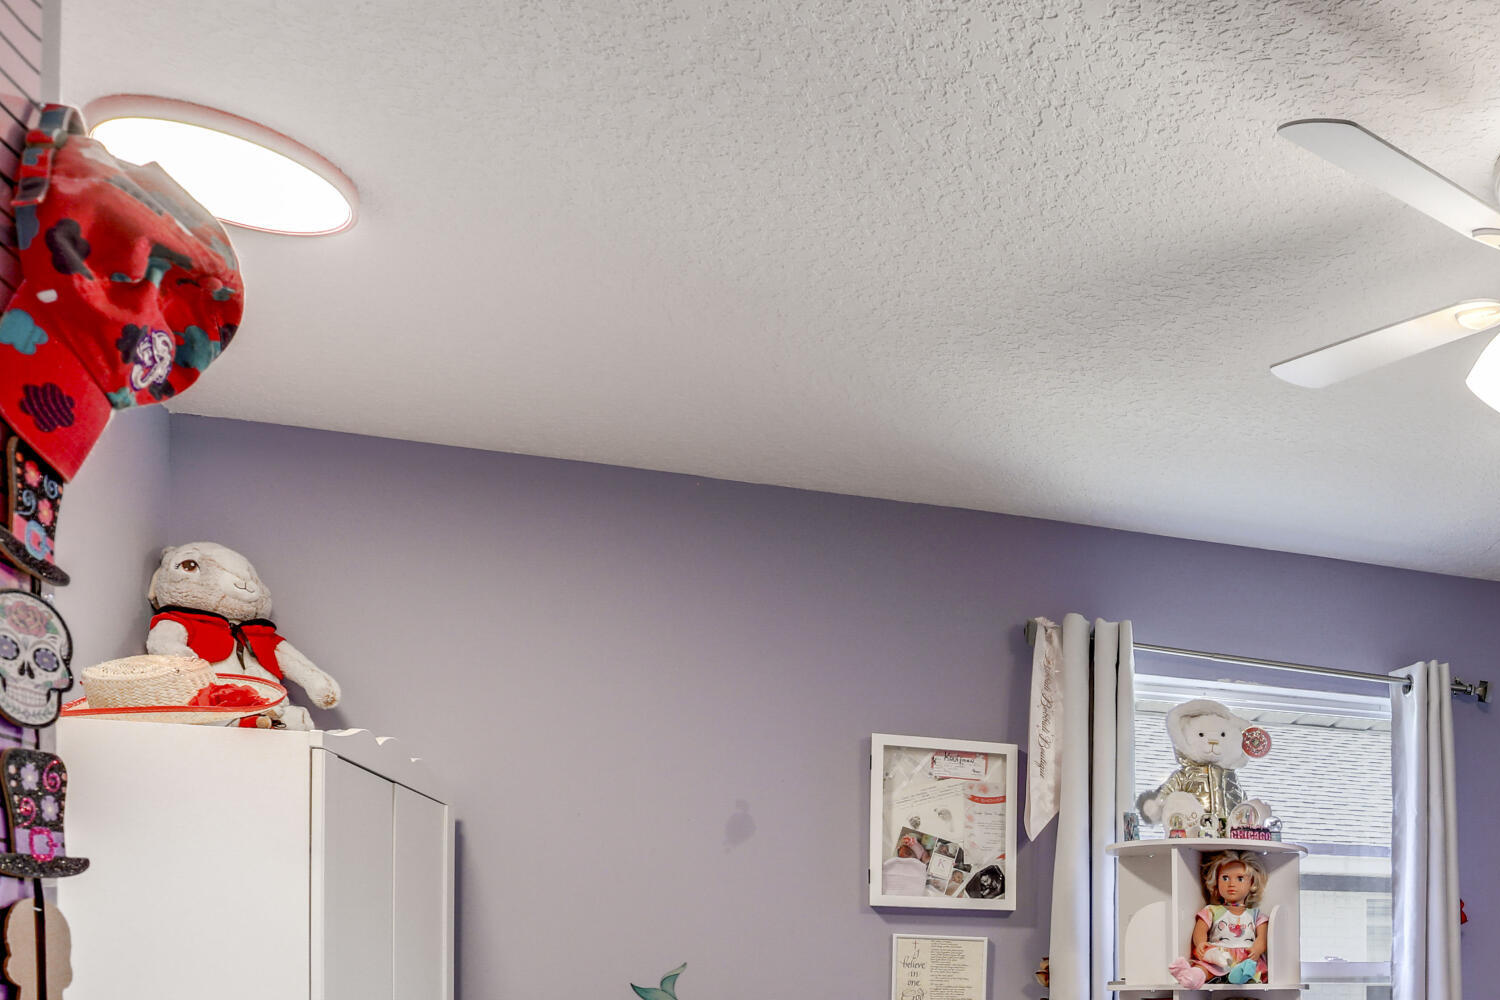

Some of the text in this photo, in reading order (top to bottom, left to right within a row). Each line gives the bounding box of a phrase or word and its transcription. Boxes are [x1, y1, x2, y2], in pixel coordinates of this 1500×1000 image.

[1034, 733, 1051, 778] Boutique
[1230, 829, 1272, 841] CHICAGO
[902, 956, 926, 970] believe
